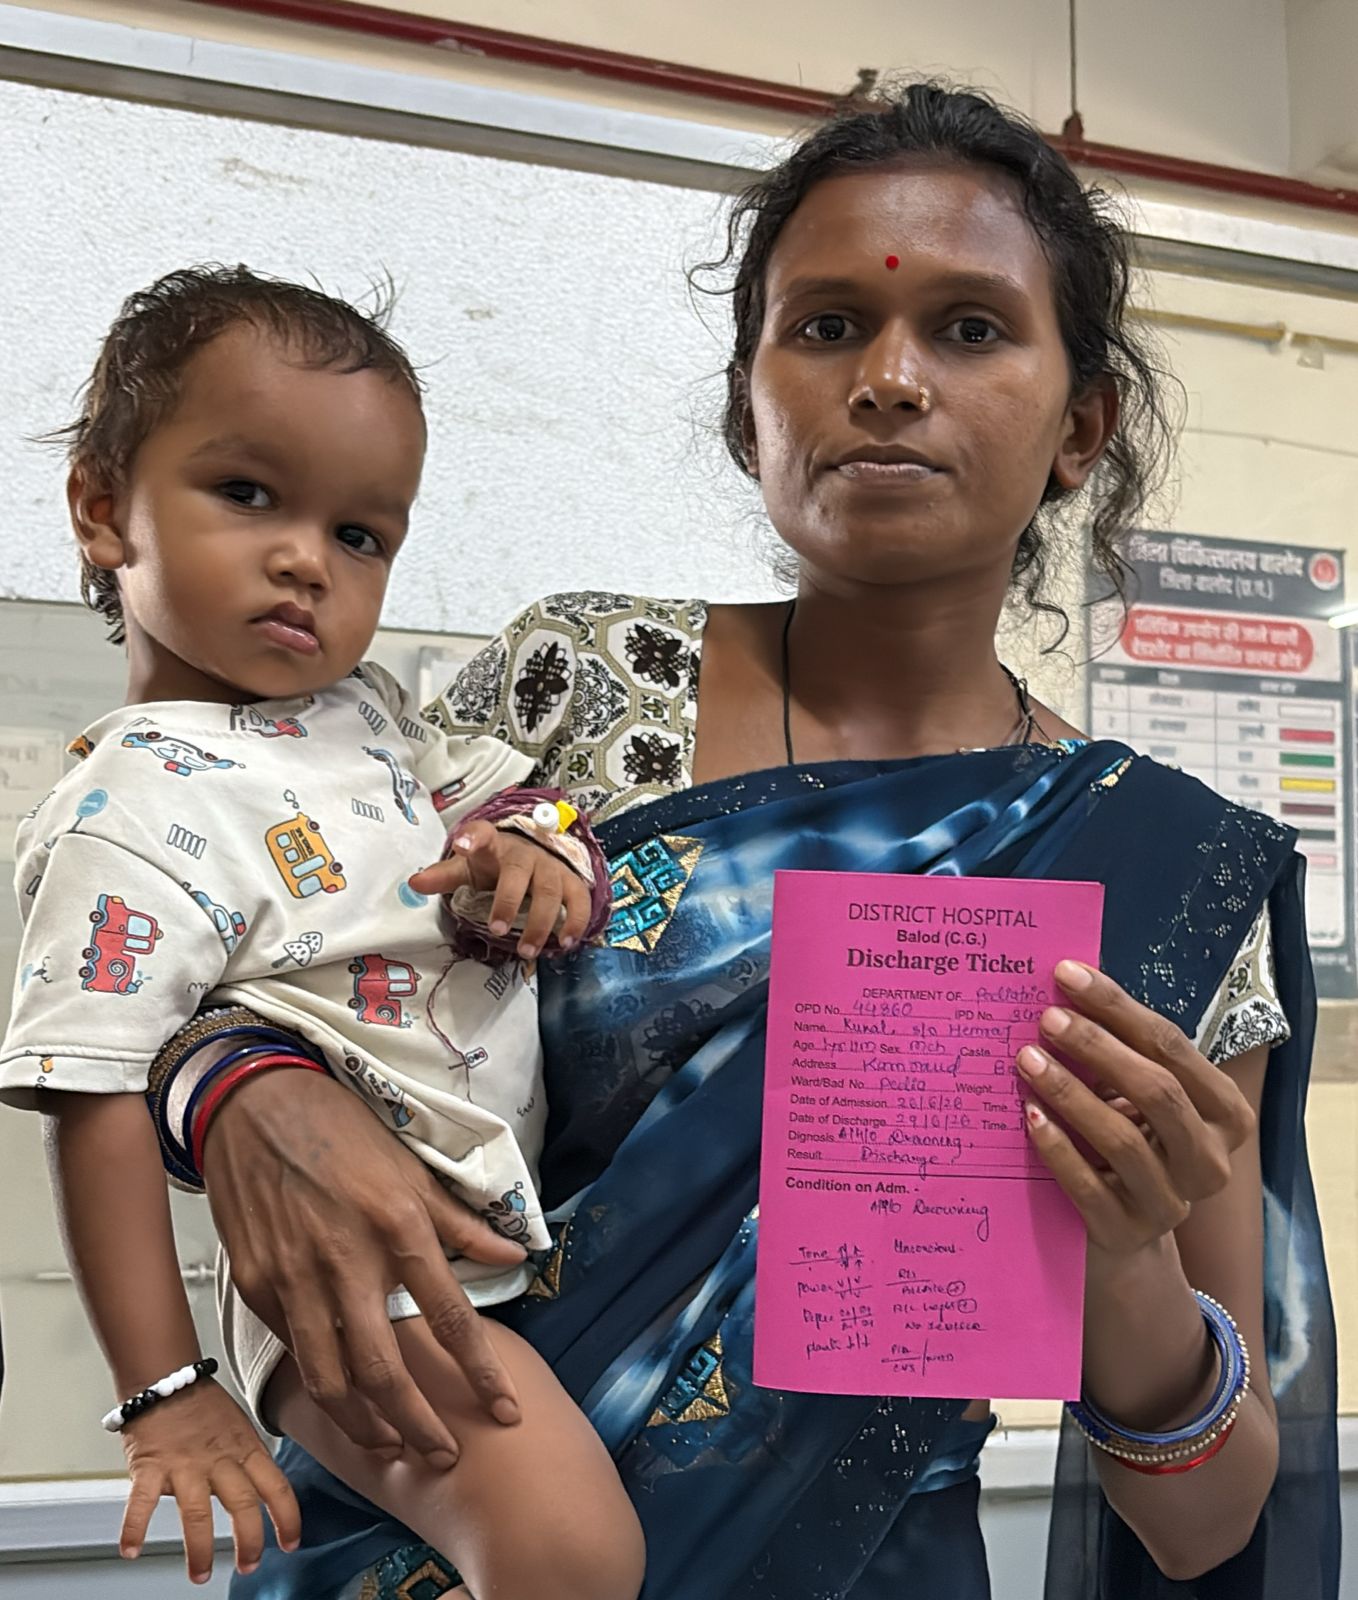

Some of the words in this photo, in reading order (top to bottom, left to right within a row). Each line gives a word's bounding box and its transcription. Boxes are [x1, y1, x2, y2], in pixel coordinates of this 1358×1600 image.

[849, 903, 936, 923] DISTRICT
[942, 908, 1038, 928] HOSPITAL
[897, 930, 940, 944] Balod
[944, 931, 987, 948] (C.G.)
[846, 948, 959, 975] Discharge
[965, 953, 1034, 975] Ticket
[862, 988, 943, 1001] DEPARTMENT
[946, 991, 962, 1001] OF
[795, 1003, 821, 1014] OPD
[955, 1010, 974, 1019] IPD
[794, 1022, 826, 1032] Name
[793, 1040, 815, 1052] Age
[880, 1043, 899, 1054] Sex
[960, 1046, 991, 1057] Caste
[792, 1058, 836, 1069] Address
[956, 1082, 993, 1095] Weight
[790, 1094, 816, 1105] Date
[819, 1096, 829, 1105] of
[832, 1097, 888, 1108] Admission
[982, 1102, 1008, 1112] Time
[789, 1112, 815, 1123] Date
[818, 1114, 829, 1123] of
[832, 1114, 887, 1129] Discharge
[982, 1120, 1007, 1130] Time
[788, 1130, 834, 1143] Dignosis
[787, 1148, 822, 1160] Result
[785, 1176, 851, 1193] Condition
[855, 1183, 872, 1194] on
[875, 1181, 910, 1194] Adm.
